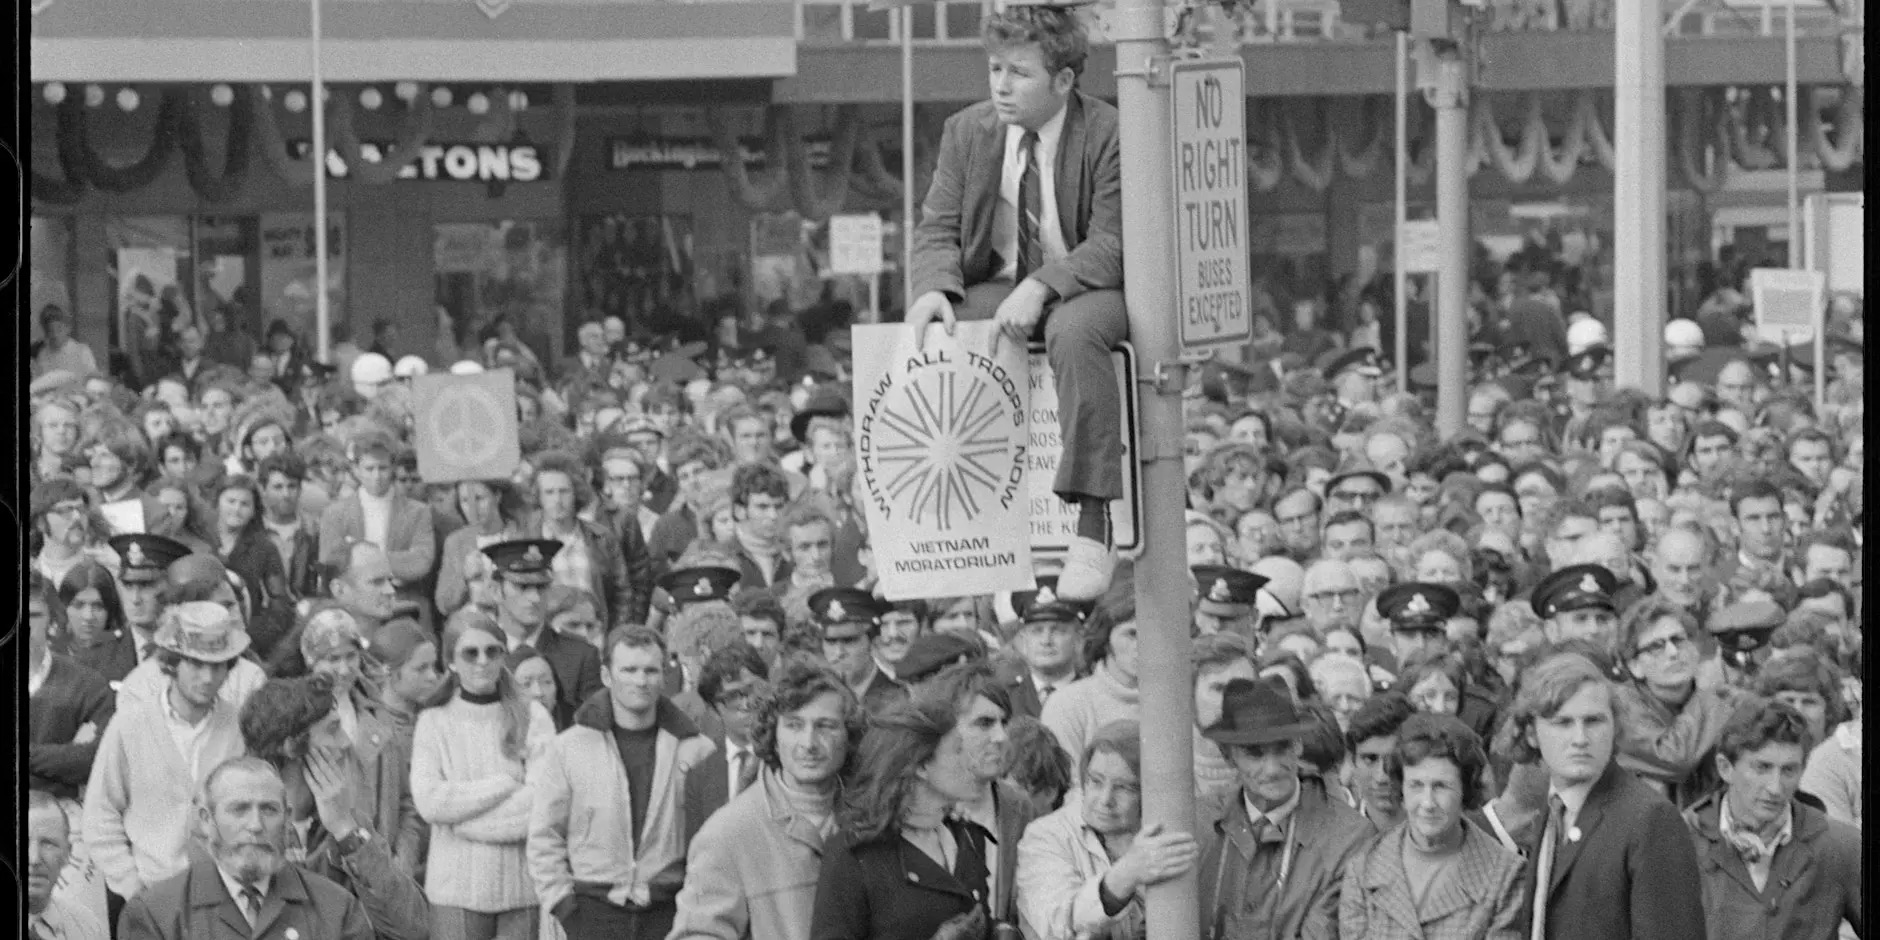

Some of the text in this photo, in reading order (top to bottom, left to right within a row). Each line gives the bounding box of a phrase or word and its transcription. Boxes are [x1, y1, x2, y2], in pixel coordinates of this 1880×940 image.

[1195, 77, 1222, 130] NO
[1182, 136, 1240, 192] RIGHT
[1185, 197, 1238, 252] TURN
[1198, 257, 1233, 289] BUSES
[1188, 290, 1242, 325] EXCEPTED
[860, 350, 1027, 521] WITHDRAW ALL TROOPS NOW
[909, 536, 991, 555] VIETNAM
[1029, 520, 1052, 536] THE
[895, 552, 1016, 574] MORATORIUM
